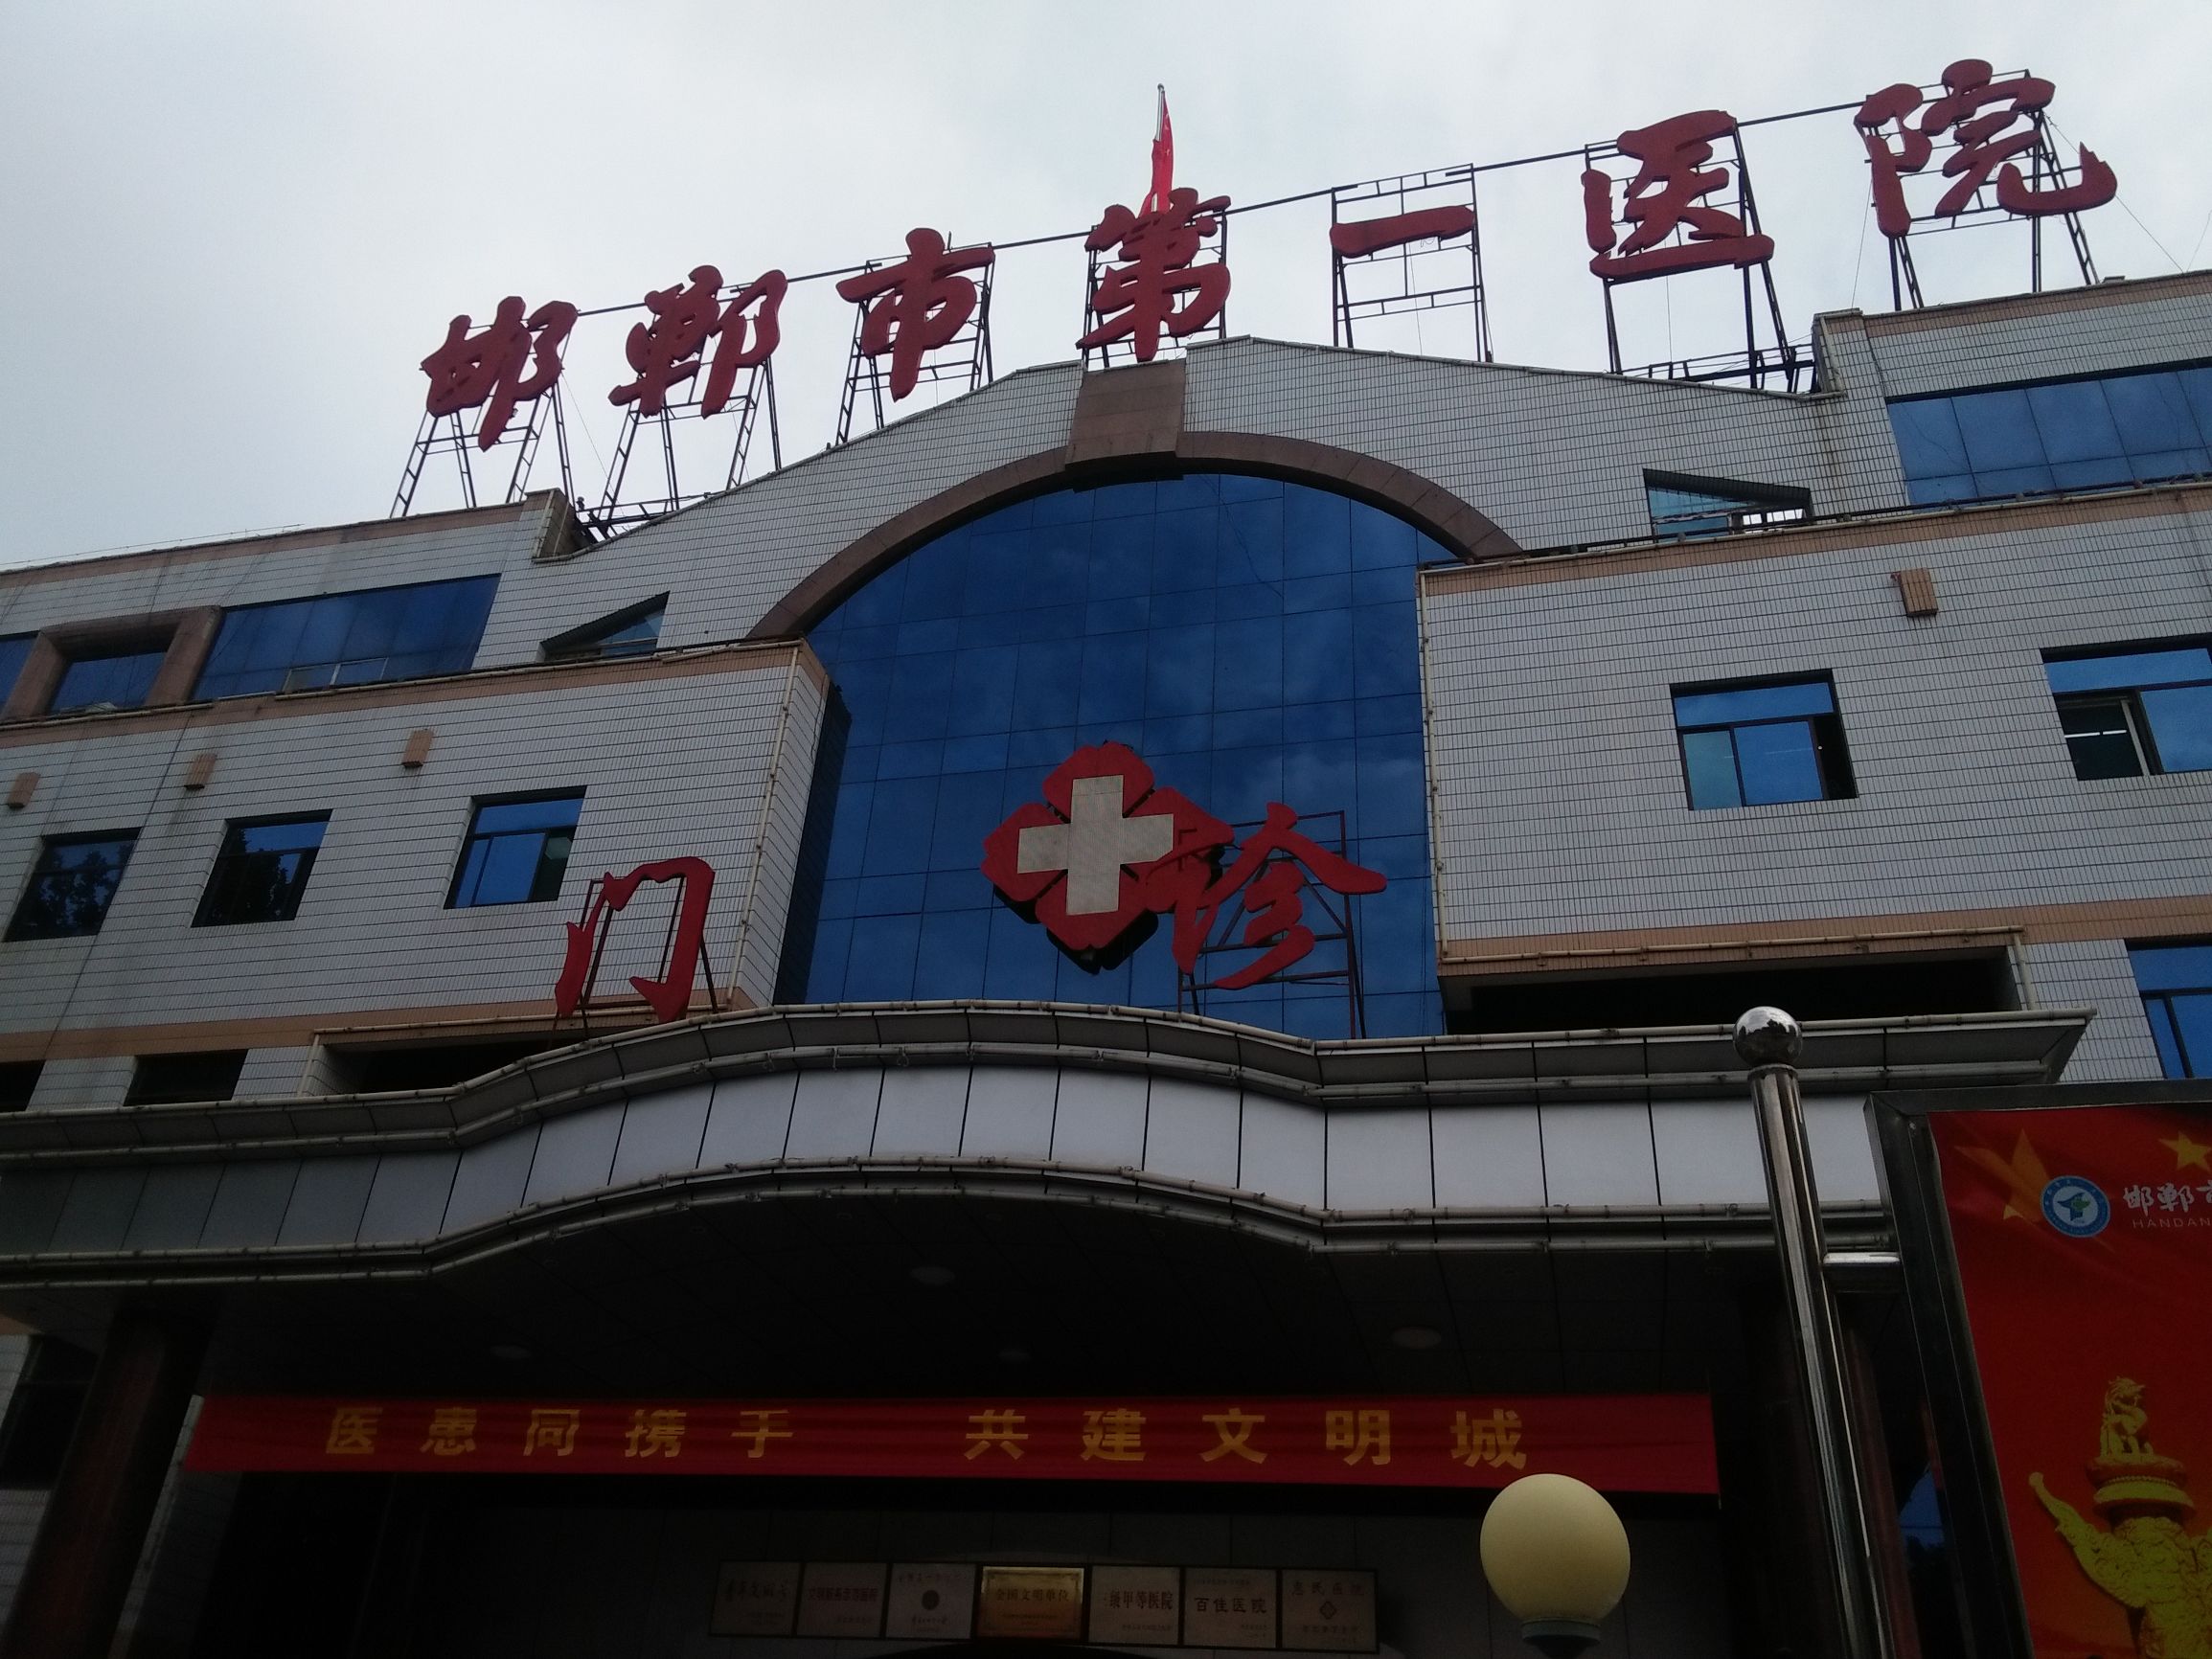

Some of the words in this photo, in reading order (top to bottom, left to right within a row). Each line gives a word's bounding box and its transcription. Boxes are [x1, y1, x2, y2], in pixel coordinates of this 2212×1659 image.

[421, 57, 2117, 452] 邯郸市第一医院
[2132, 1217, 2212, 1229] HANDAN
[325, 1405, 794, 1458] 医患同携手
[962, 1407, 1529, 1470] 共建文明城
[1194, 1597, 1267, 1614] 百佳医院
